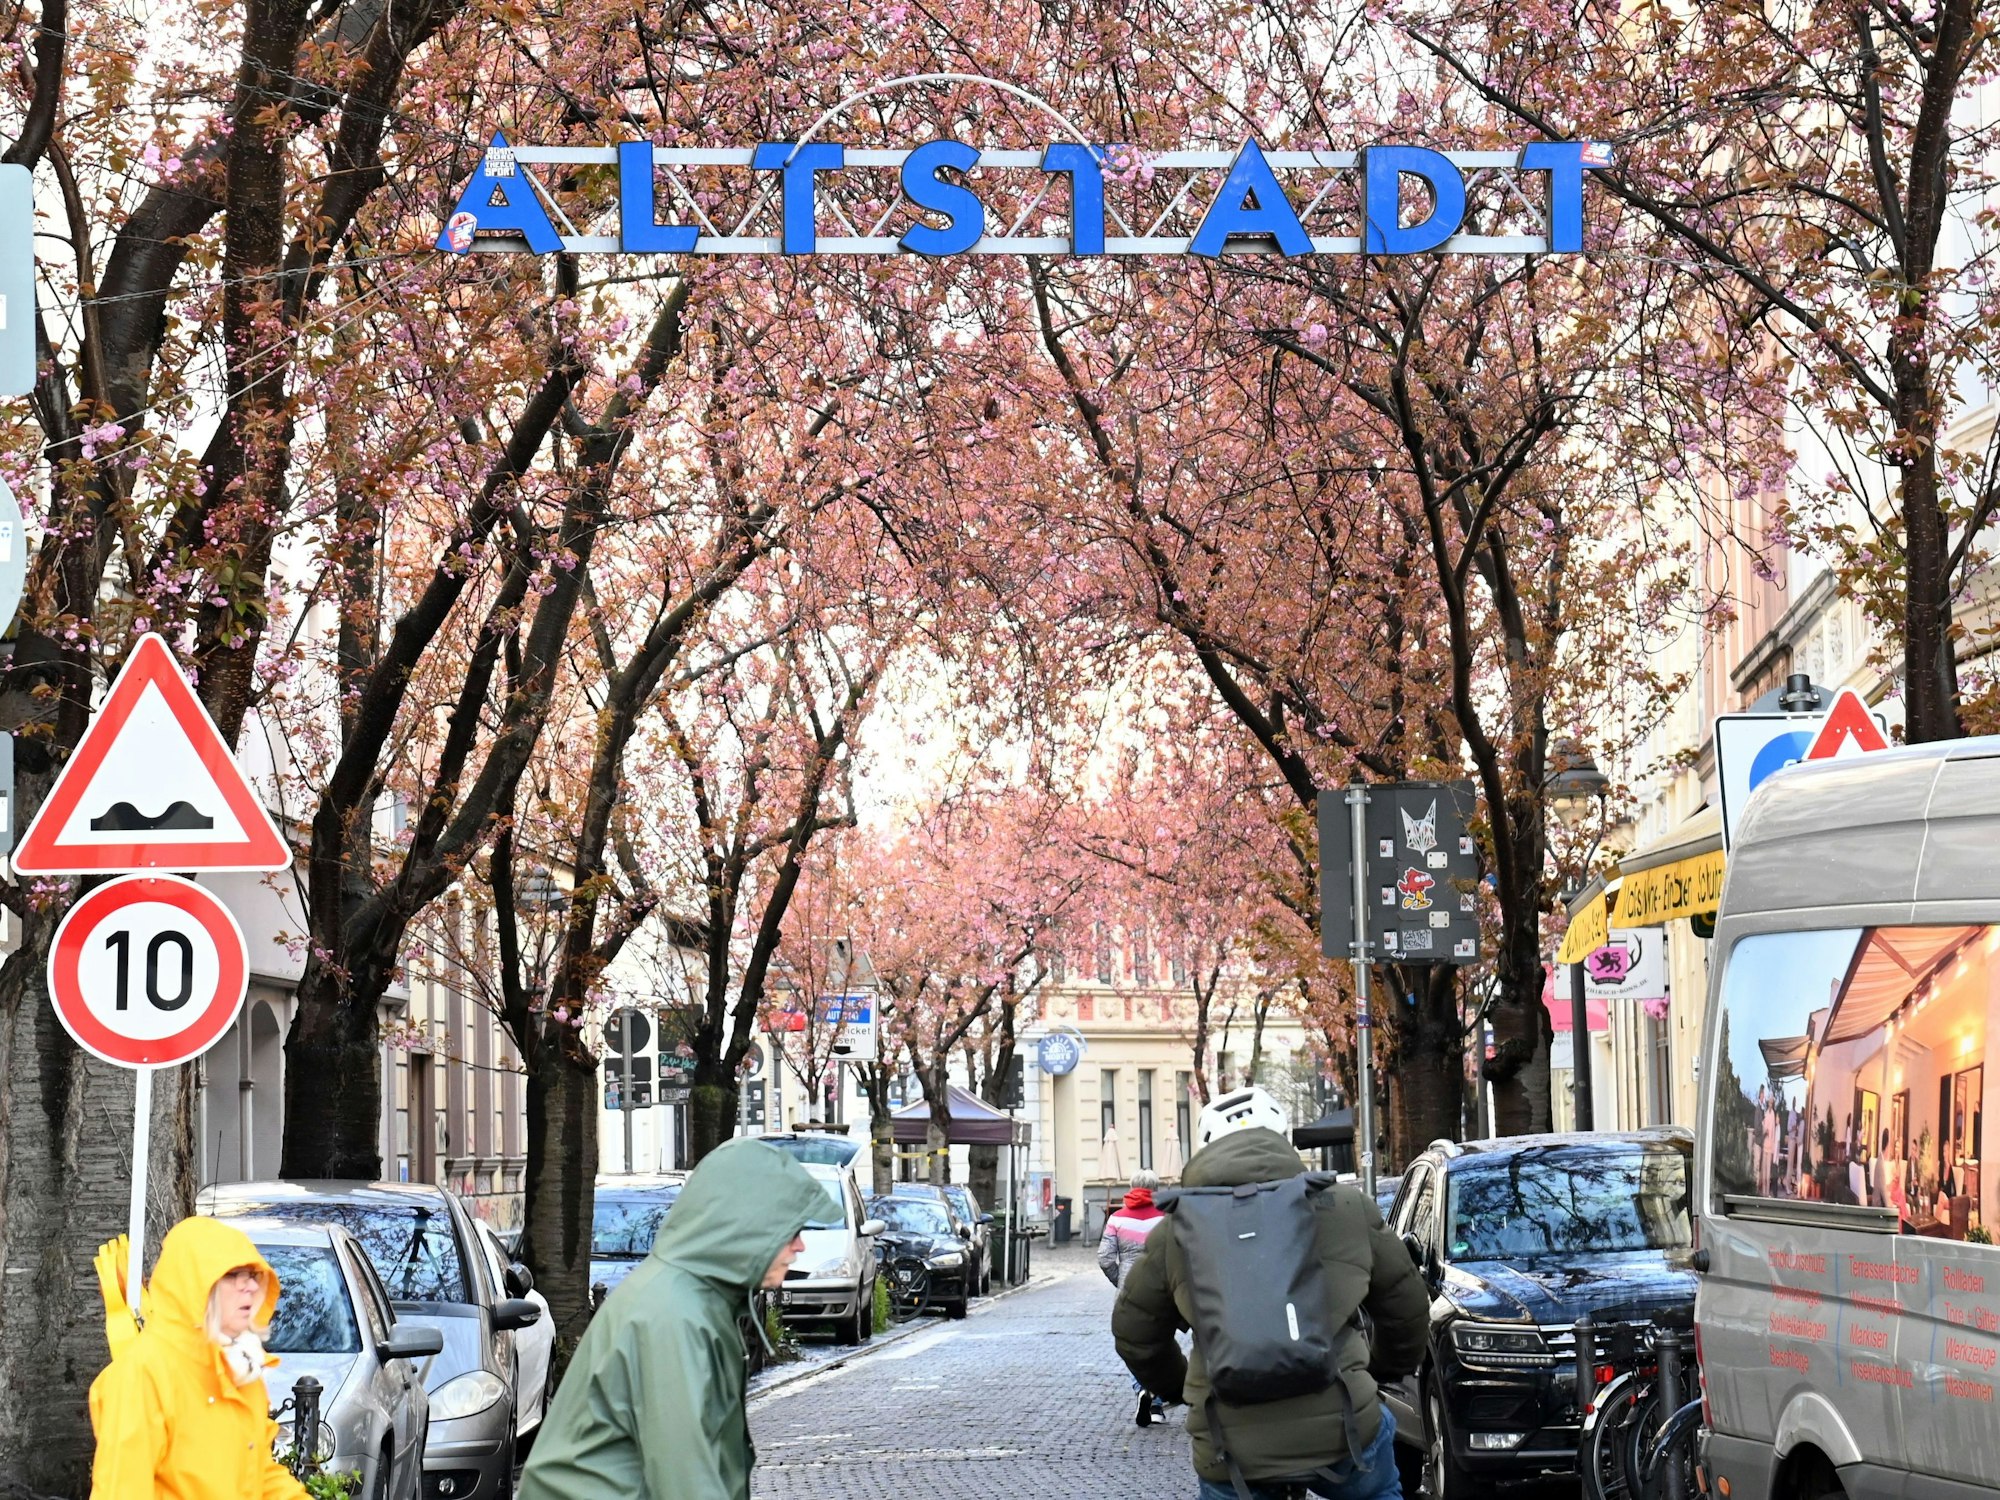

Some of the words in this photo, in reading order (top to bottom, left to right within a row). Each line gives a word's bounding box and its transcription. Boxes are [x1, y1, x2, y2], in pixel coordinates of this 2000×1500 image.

[485, 168, 515, 177] SPORT
[435, 130, 1613, 257] ALTSTADT
[105, 930, 194, 1012] 10
[846, 1026, 871, 1035] icket
[1849, 1254, 1920, 1285] Terrassendächer
[1944, 1302, 1964, 1327] Tore
[1850, 1322, 1888, 1349] Markisen
[1946, 1337, 1996, 1371] Werkzeuge
[1851, 1360, 1913, 1389] Insektenschutz
[1945, 1375, 1993, 1401] Maschinen
